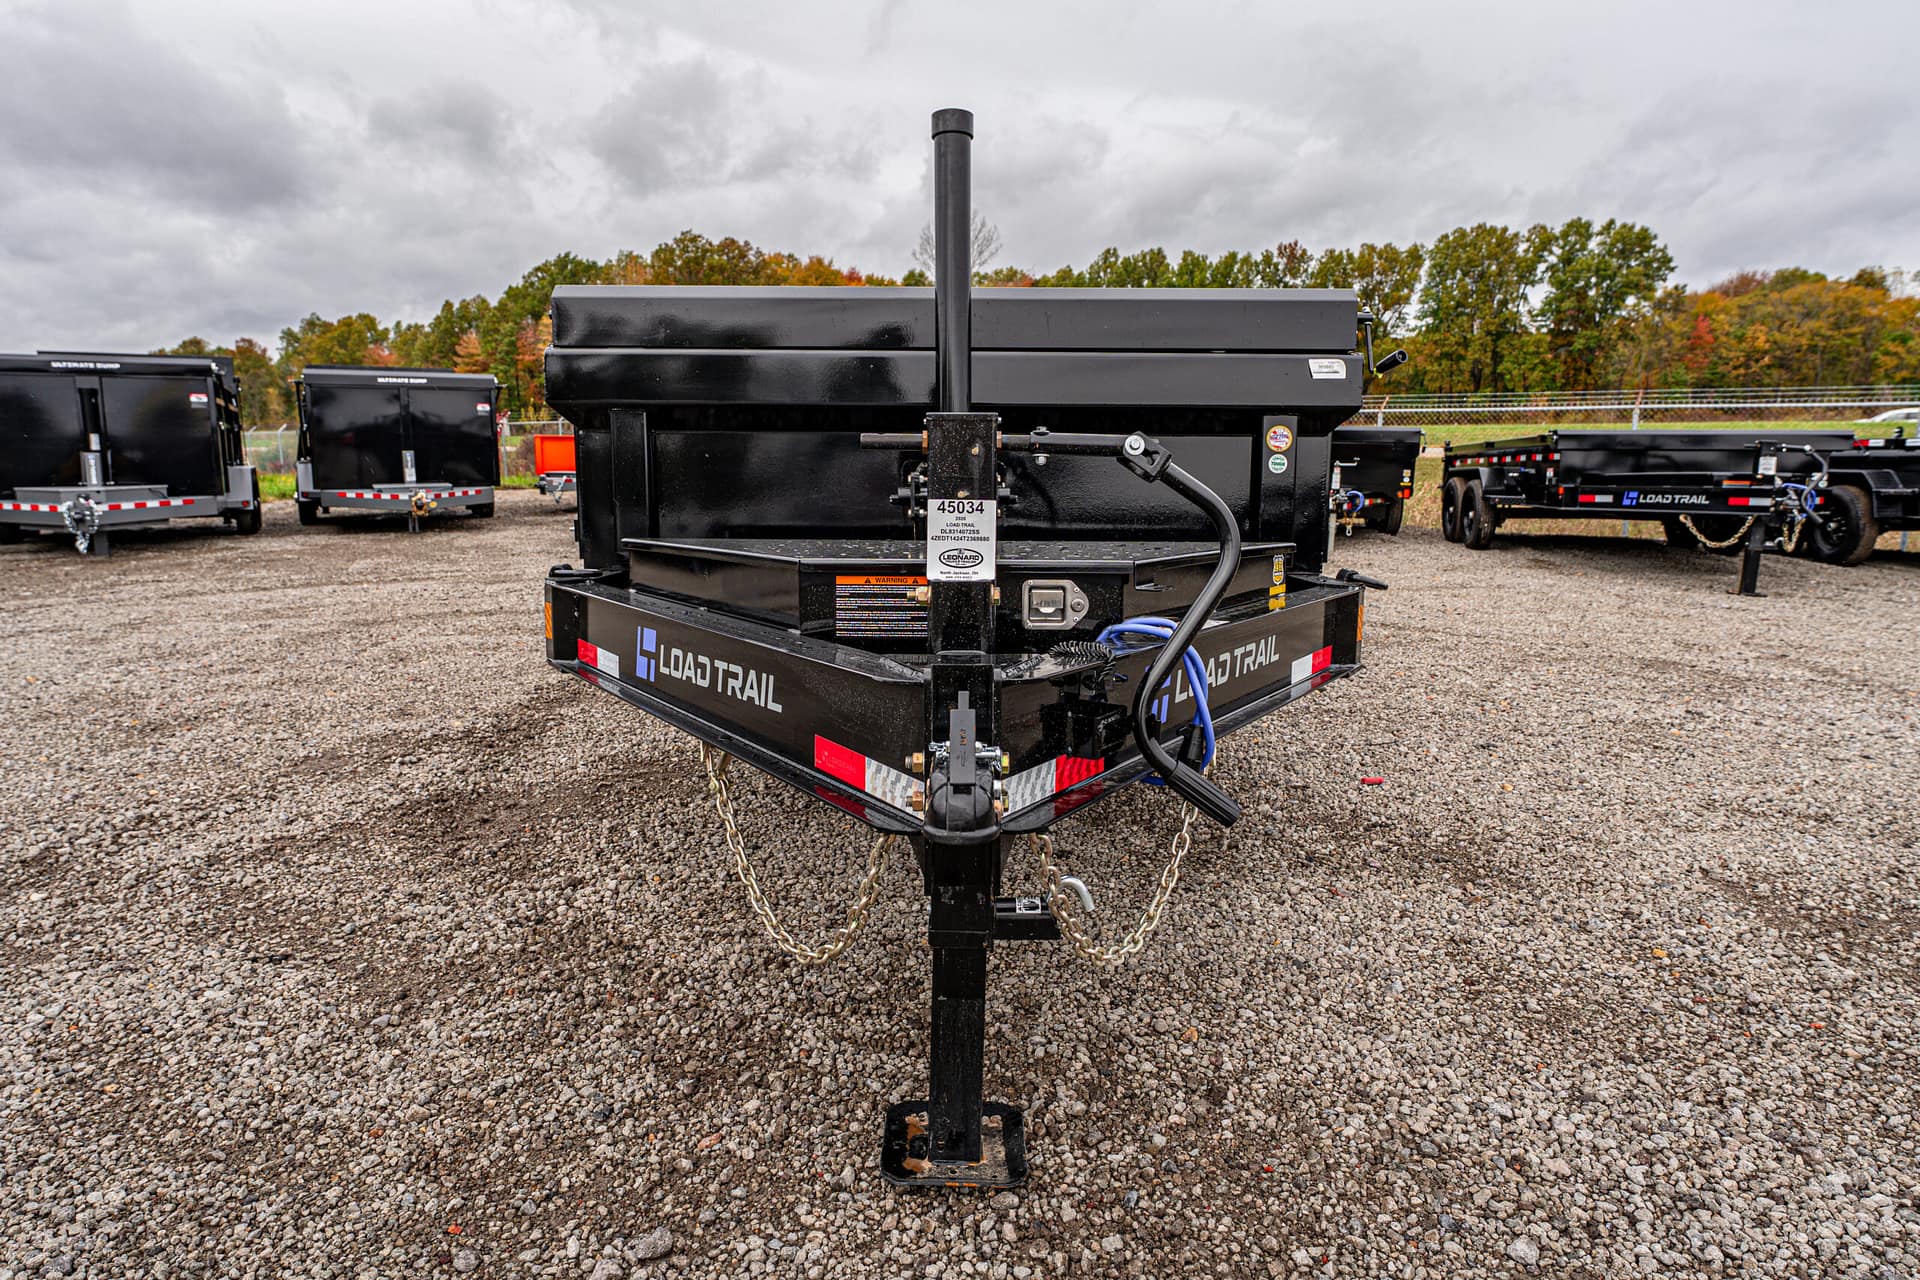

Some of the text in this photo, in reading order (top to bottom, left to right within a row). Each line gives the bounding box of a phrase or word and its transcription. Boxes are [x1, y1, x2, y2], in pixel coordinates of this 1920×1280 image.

[937, 500, 985, 514] 45034
[1639, 494, 1710, 504] LOAD TRAIL
[659, 643, 783, 714] LOAD TRAIL
[1174, 633, 1281, 704] LAD TRAIL
